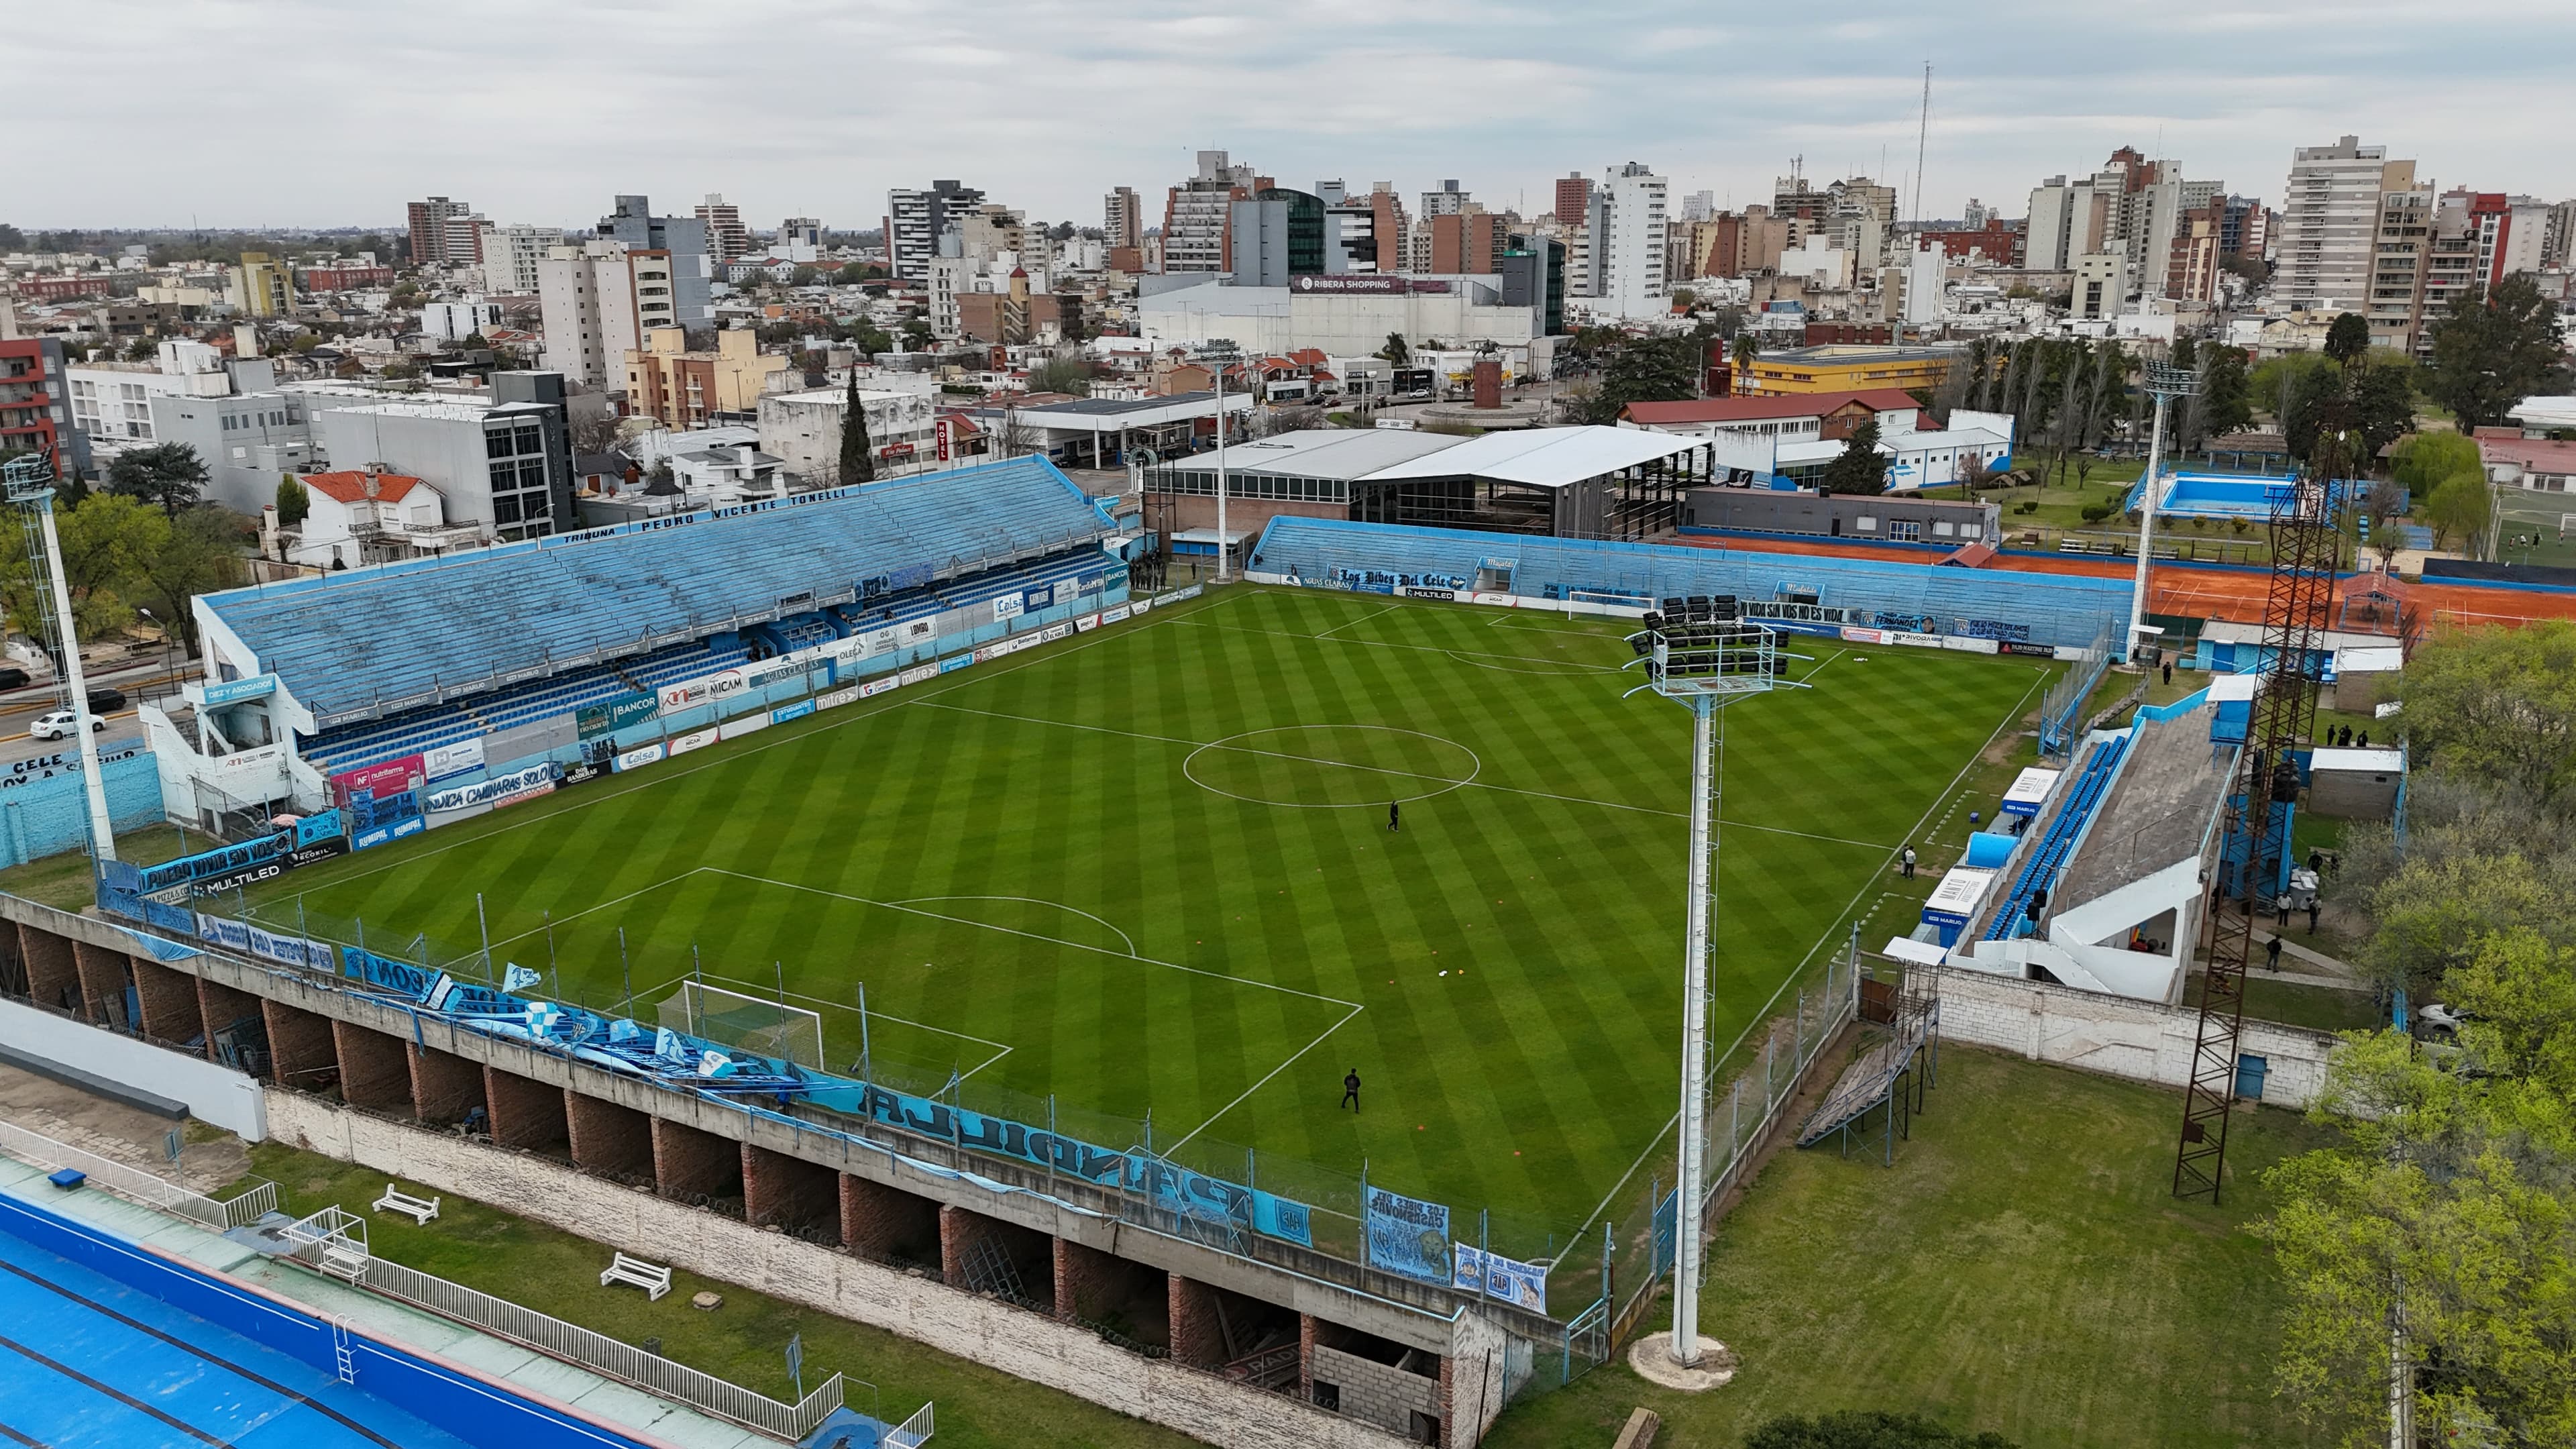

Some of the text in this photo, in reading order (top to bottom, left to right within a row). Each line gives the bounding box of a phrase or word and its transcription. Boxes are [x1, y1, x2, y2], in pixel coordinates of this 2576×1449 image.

[1314, 280, 1344, 288] RIBERA
[1346, 280, 1391, 288] SHOPPING
[564, 489, 847, 544] TRIBUNA PEDRO VICENTE TONELLI
[1303, 578, 1349, 588] AGUAS CLARAS
[1341, 570, 1360, 582] Los
[1365, 571, 1395, 584] Pibes
[1399, 574, 1419, 586] Del
[1414, 591, 1453, 599] MULTILED
[1782, 604, 1797, 619] VOS
[1799, 606, 1809, 620] NO
[1812, 606, 1822, 621] ES
[902, 668, 928, 686] mitre
[209, 690, 225, 699] DIEZ
[230, 680, 272, 695] ASOCIADOS
[710, 677, 743, 696] MICAM
[617, 697, 655, 716] BANCOR
[777, 701, 812, 716] ESTUDIANTES
[816, 692, 847, 711] mitre
[627, 749, 655, 764] Calsa
[575, 766, 588, 774] DOS
[466, 778, 521, 805] CAMINARAS
[523, 766, 548, 786] SOLO
[394, 818, 422, 837] RUMIPAL
[359, 829, 388, 849] RUMIPAL
[193, 855, 227, 877] VIVIR
[229, 846, 250, 865] SIN
[299, 848, 329, 860] ECOKIL
[207, 865, 280, 894] MULTILED
[158, 891, 175, 904] PIZZA
[1938, 879, 1966, 900] MANTO
